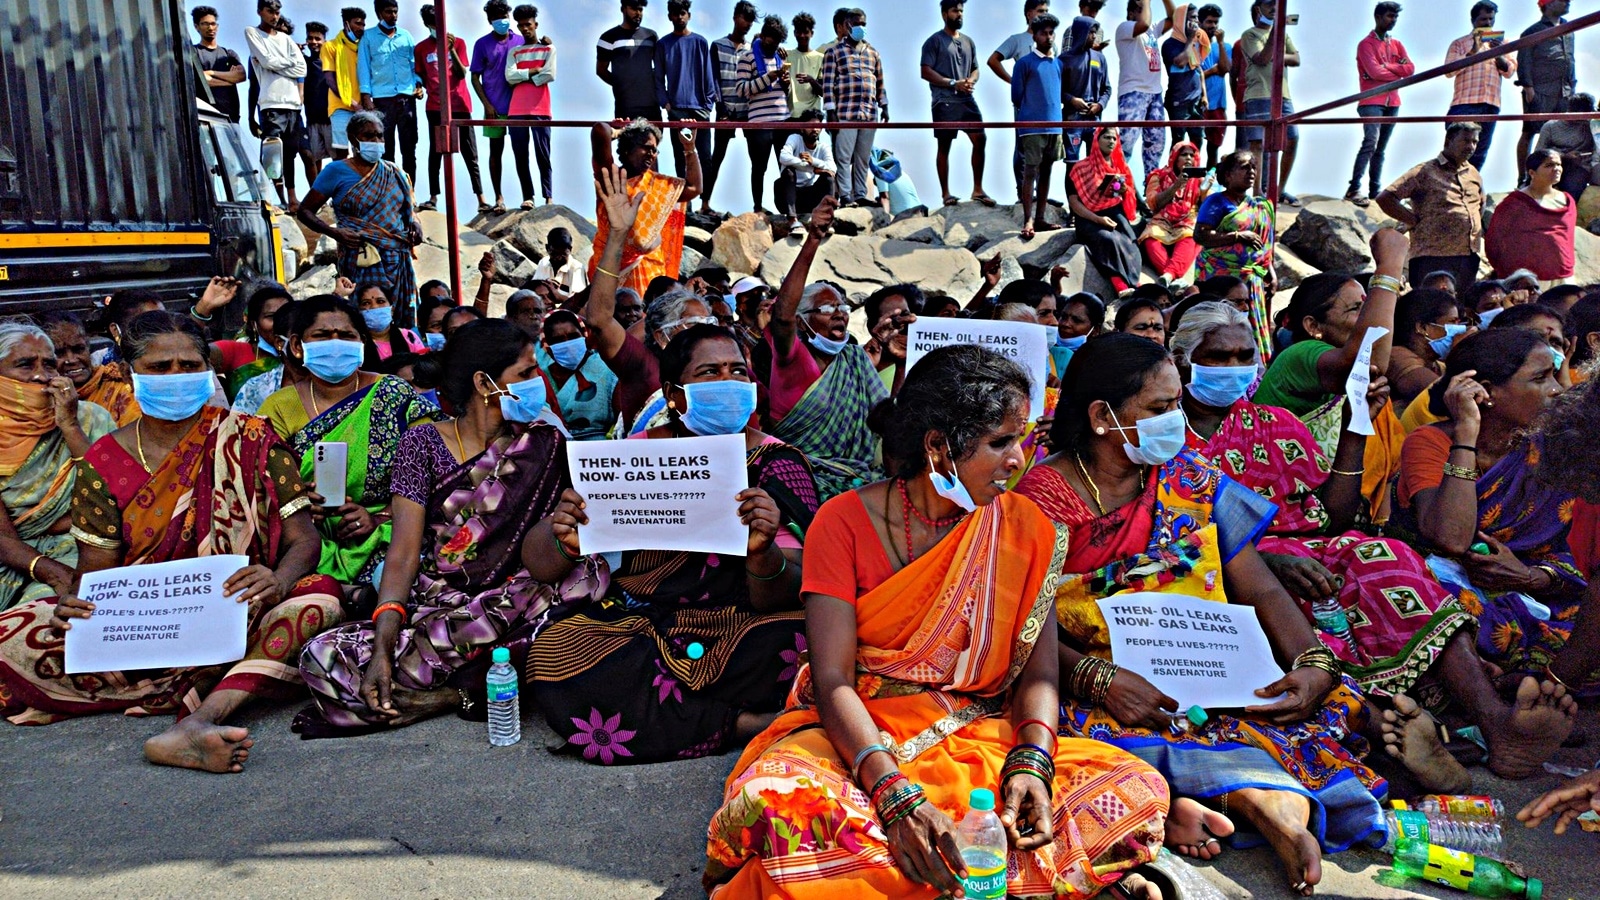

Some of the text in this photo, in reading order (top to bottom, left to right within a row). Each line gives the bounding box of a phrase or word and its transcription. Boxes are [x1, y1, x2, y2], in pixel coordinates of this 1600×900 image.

[916, 331, 953, 341] THEN-
[979, 336, 1018, 345] LEAKS
[579, 457, 626, 468] THEN-
[659, 455, 709, 467] LEAKS
[580, 469, 711, 481] NOW- GAS LEAKS
[640, 492, 706, 500] LIVES-??????
[89, 579, 133, 592] THEN-
[165, 572, 212, 585] LEAKS
[85, 585, 212, 602] NOW- GAS LEAKS
[138, 606, 204, 616] LIVES-??????
[1111, 606, 1158, 615] THEN-
[1187, 609, 1232, 623] LEAKS
[103, 624, 181, 633] #SAVEENNORE
[1115, 617, 1238, 635] NOW- GAS LEAKS
[103, 632, 179, 642] #SAVENATURE
[1126, 638, 1239, 652] PEOPLE'S LIVES-??????
[1150, 658, 1225, 668] #SAVEENNORE
[1153, 668, 1227, 678] #SAVENATURE
